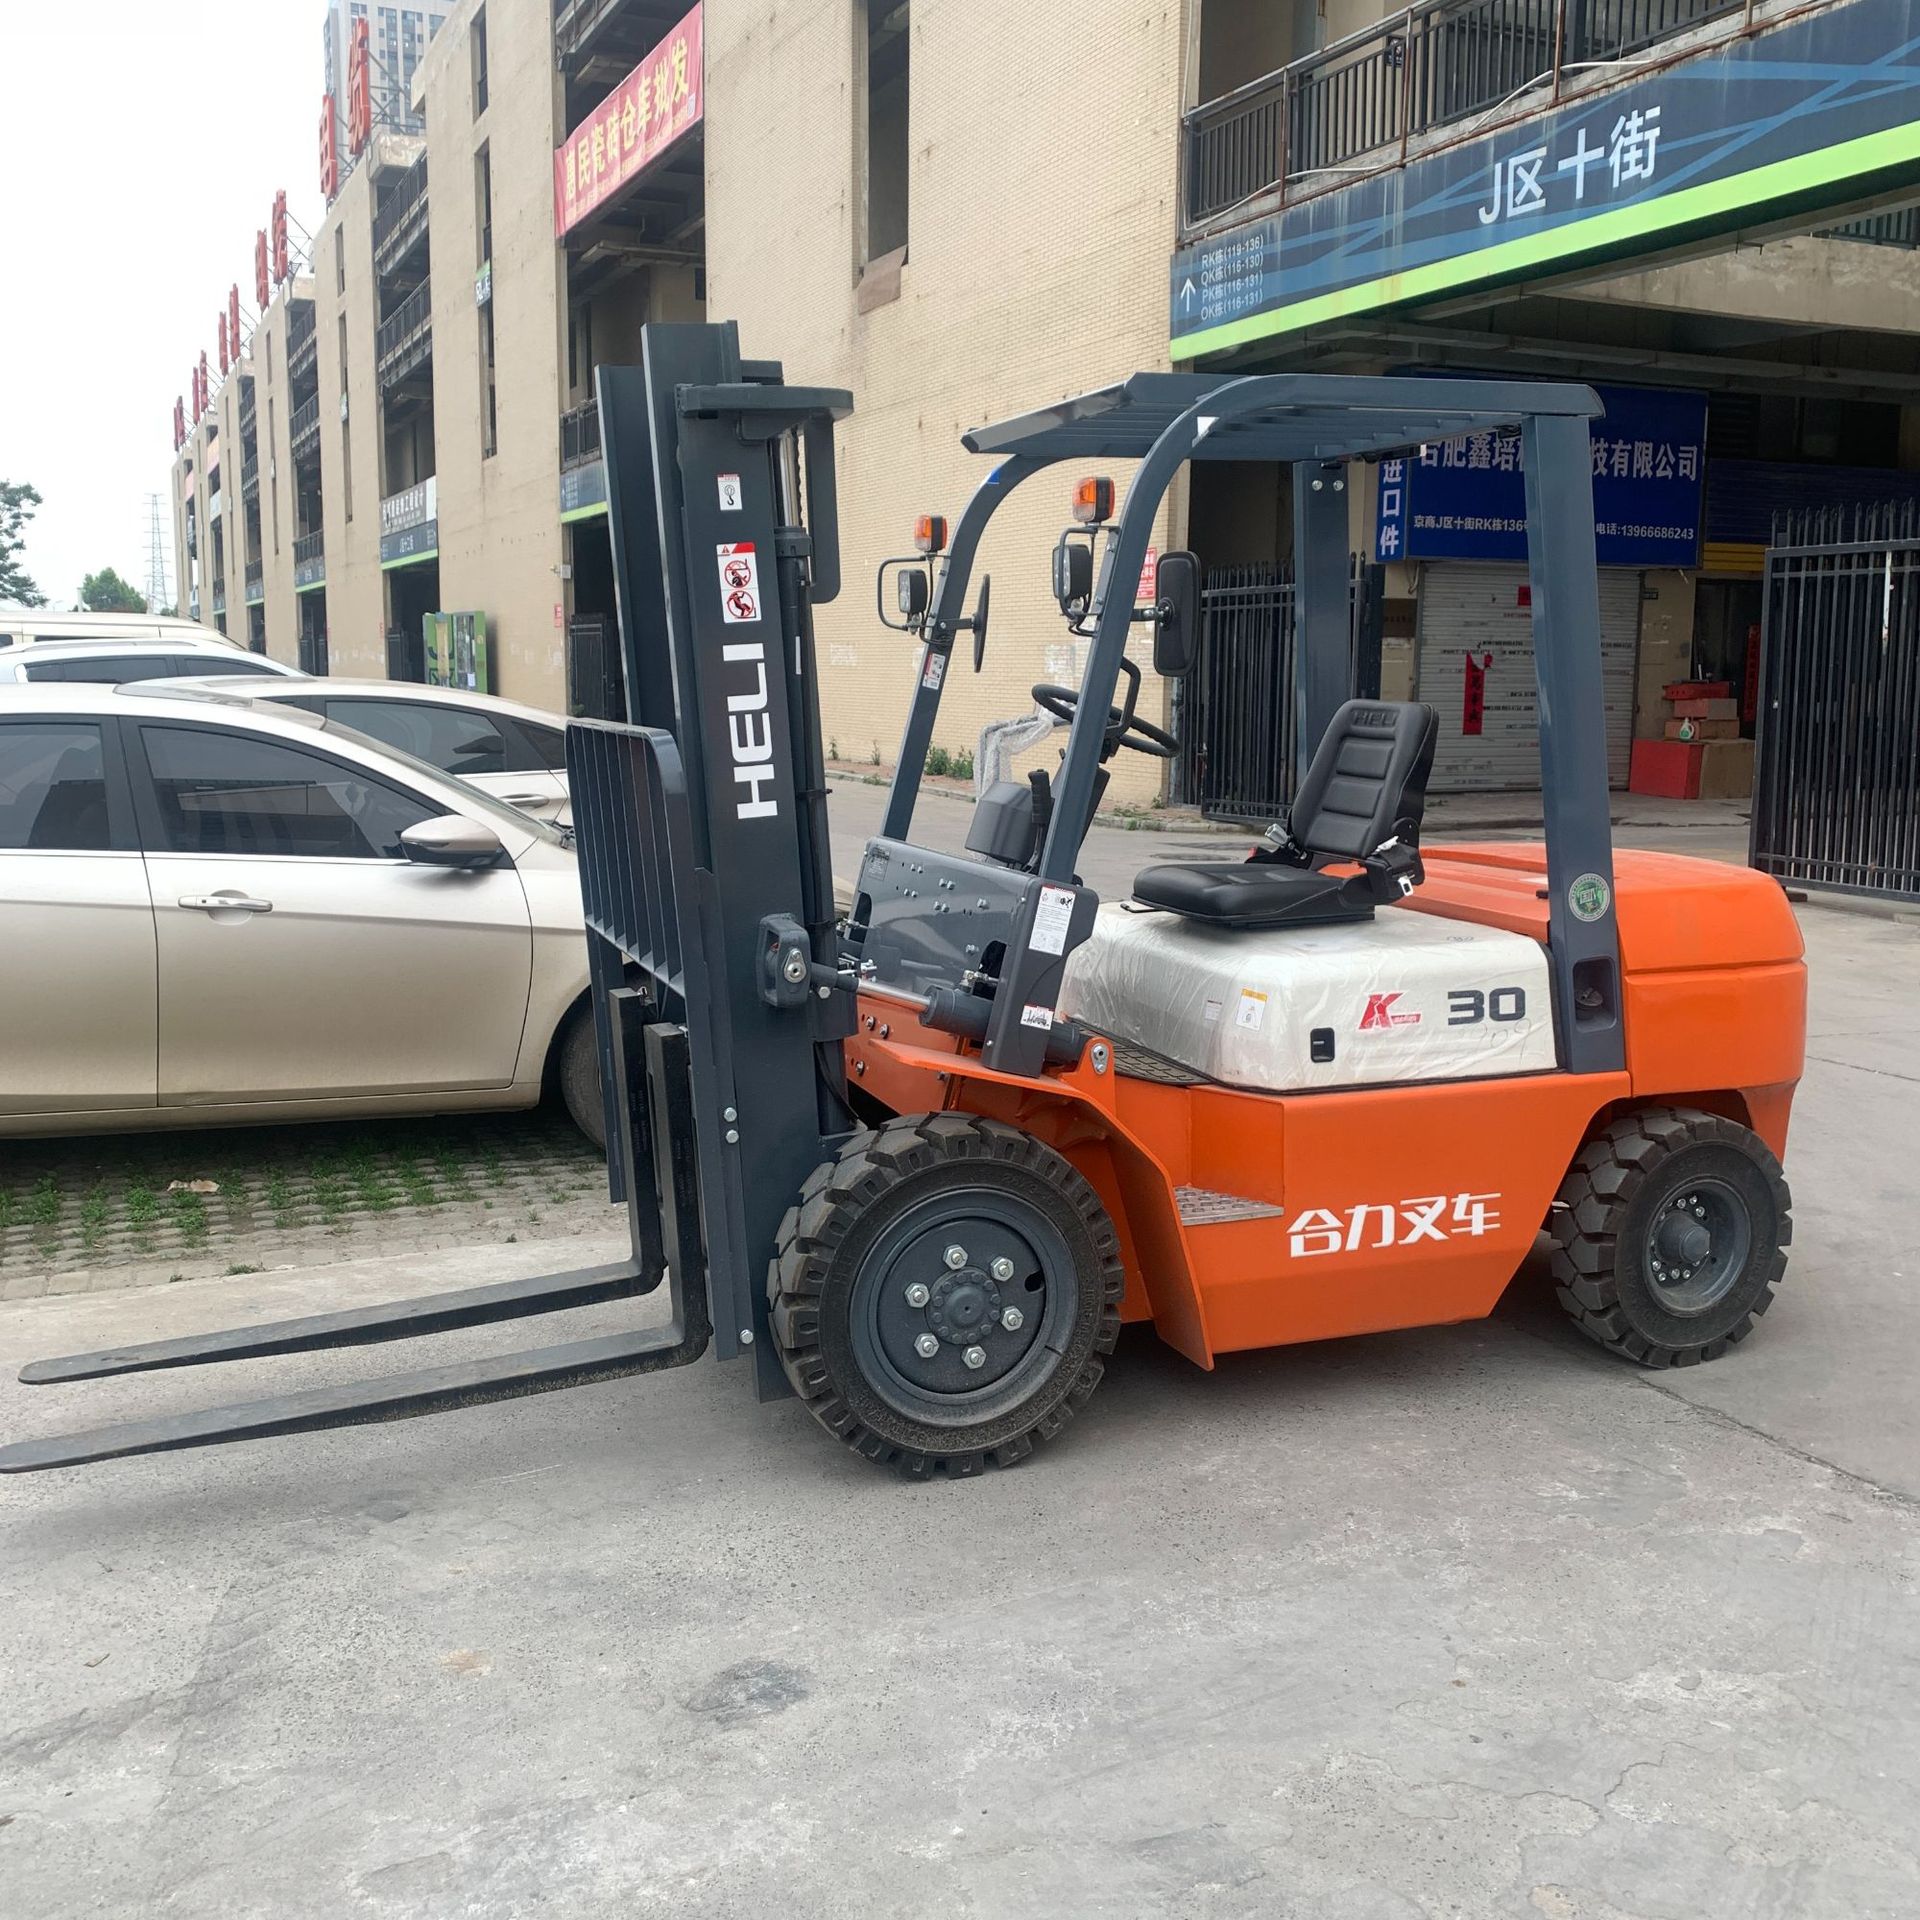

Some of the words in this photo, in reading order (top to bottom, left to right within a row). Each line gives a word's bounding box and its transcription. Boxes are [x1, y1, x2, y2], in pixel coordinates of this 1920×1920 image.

[1479, 106, 1662, 224] J区十街
[1380, 460, 1402, 556] 进口件
[1595, 522, 1694, 540] 电话:13966686243
[722, 642, 778, 819] HELI
[1352, 709, 1400, 728] HELI
[1358, 992, 1403, 1030] K
[1447, 986, 1526, 1026] 30
[1286, 1192, 1503, 1258] 合力叉车
